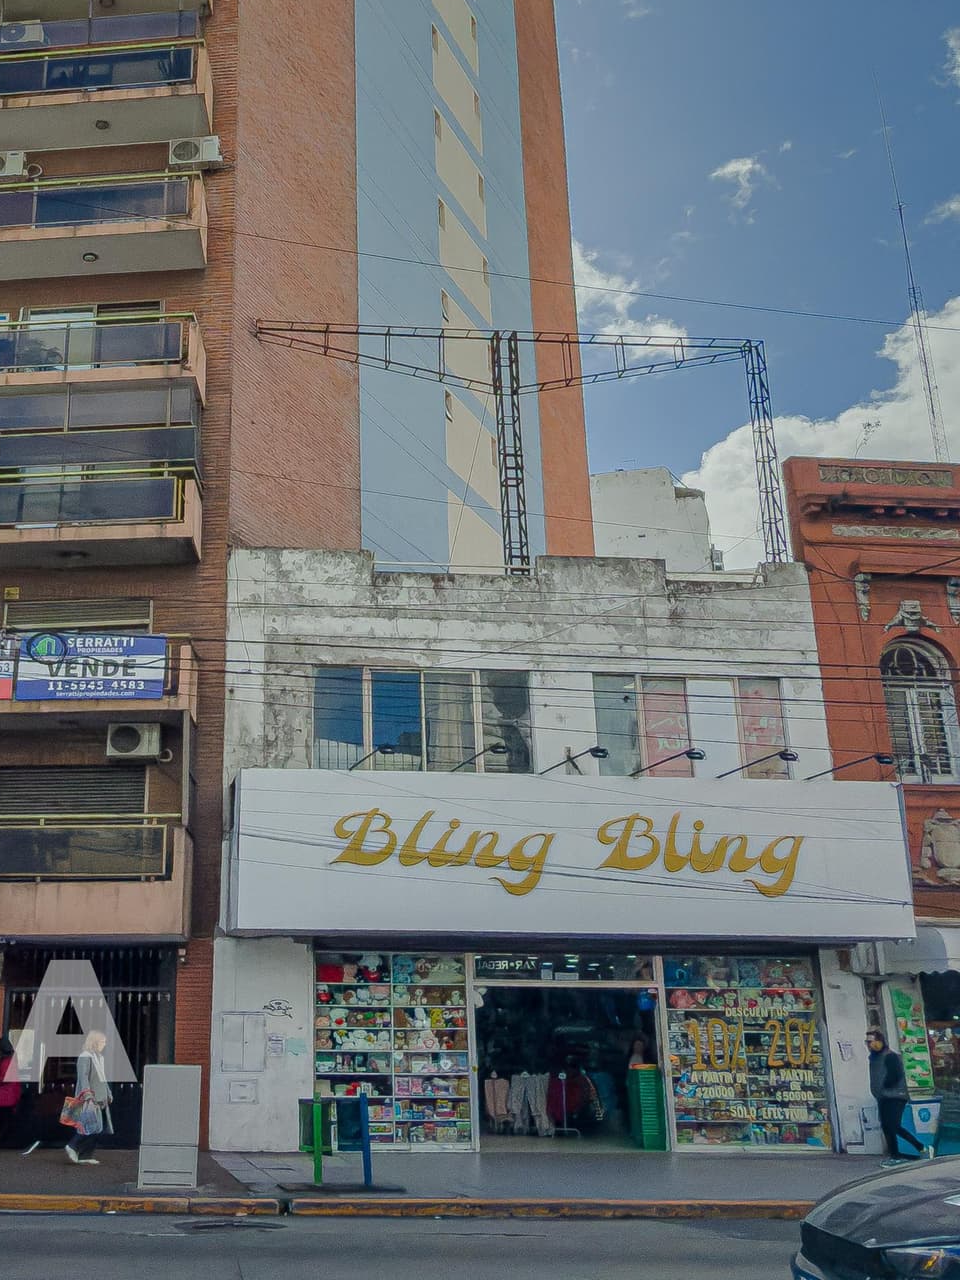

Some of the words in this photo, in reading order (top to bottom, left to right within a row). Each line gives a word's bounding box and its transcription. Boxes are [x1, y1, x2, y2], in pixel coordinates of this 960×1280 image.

[67, 636, 135, 648] SERRATTI
[46, 658, 137, 678] VENDE
[47, 680, 104, 691] 11-5945
[111, 680, 145, 690] 4583
[329, 808, 556, 895] Bling
[595, 812, 804, 897] Bling
[725, 1006, 789, 1018] DESCUENTOS
[685, 1018, 746, 1072] 10%
[765, 1018, 819, 1068] 20%
[691, 1071, 699, 1083] A
[769, 1070, 777, 1086] A
[729, 1104, 757, 1119] SOLO
